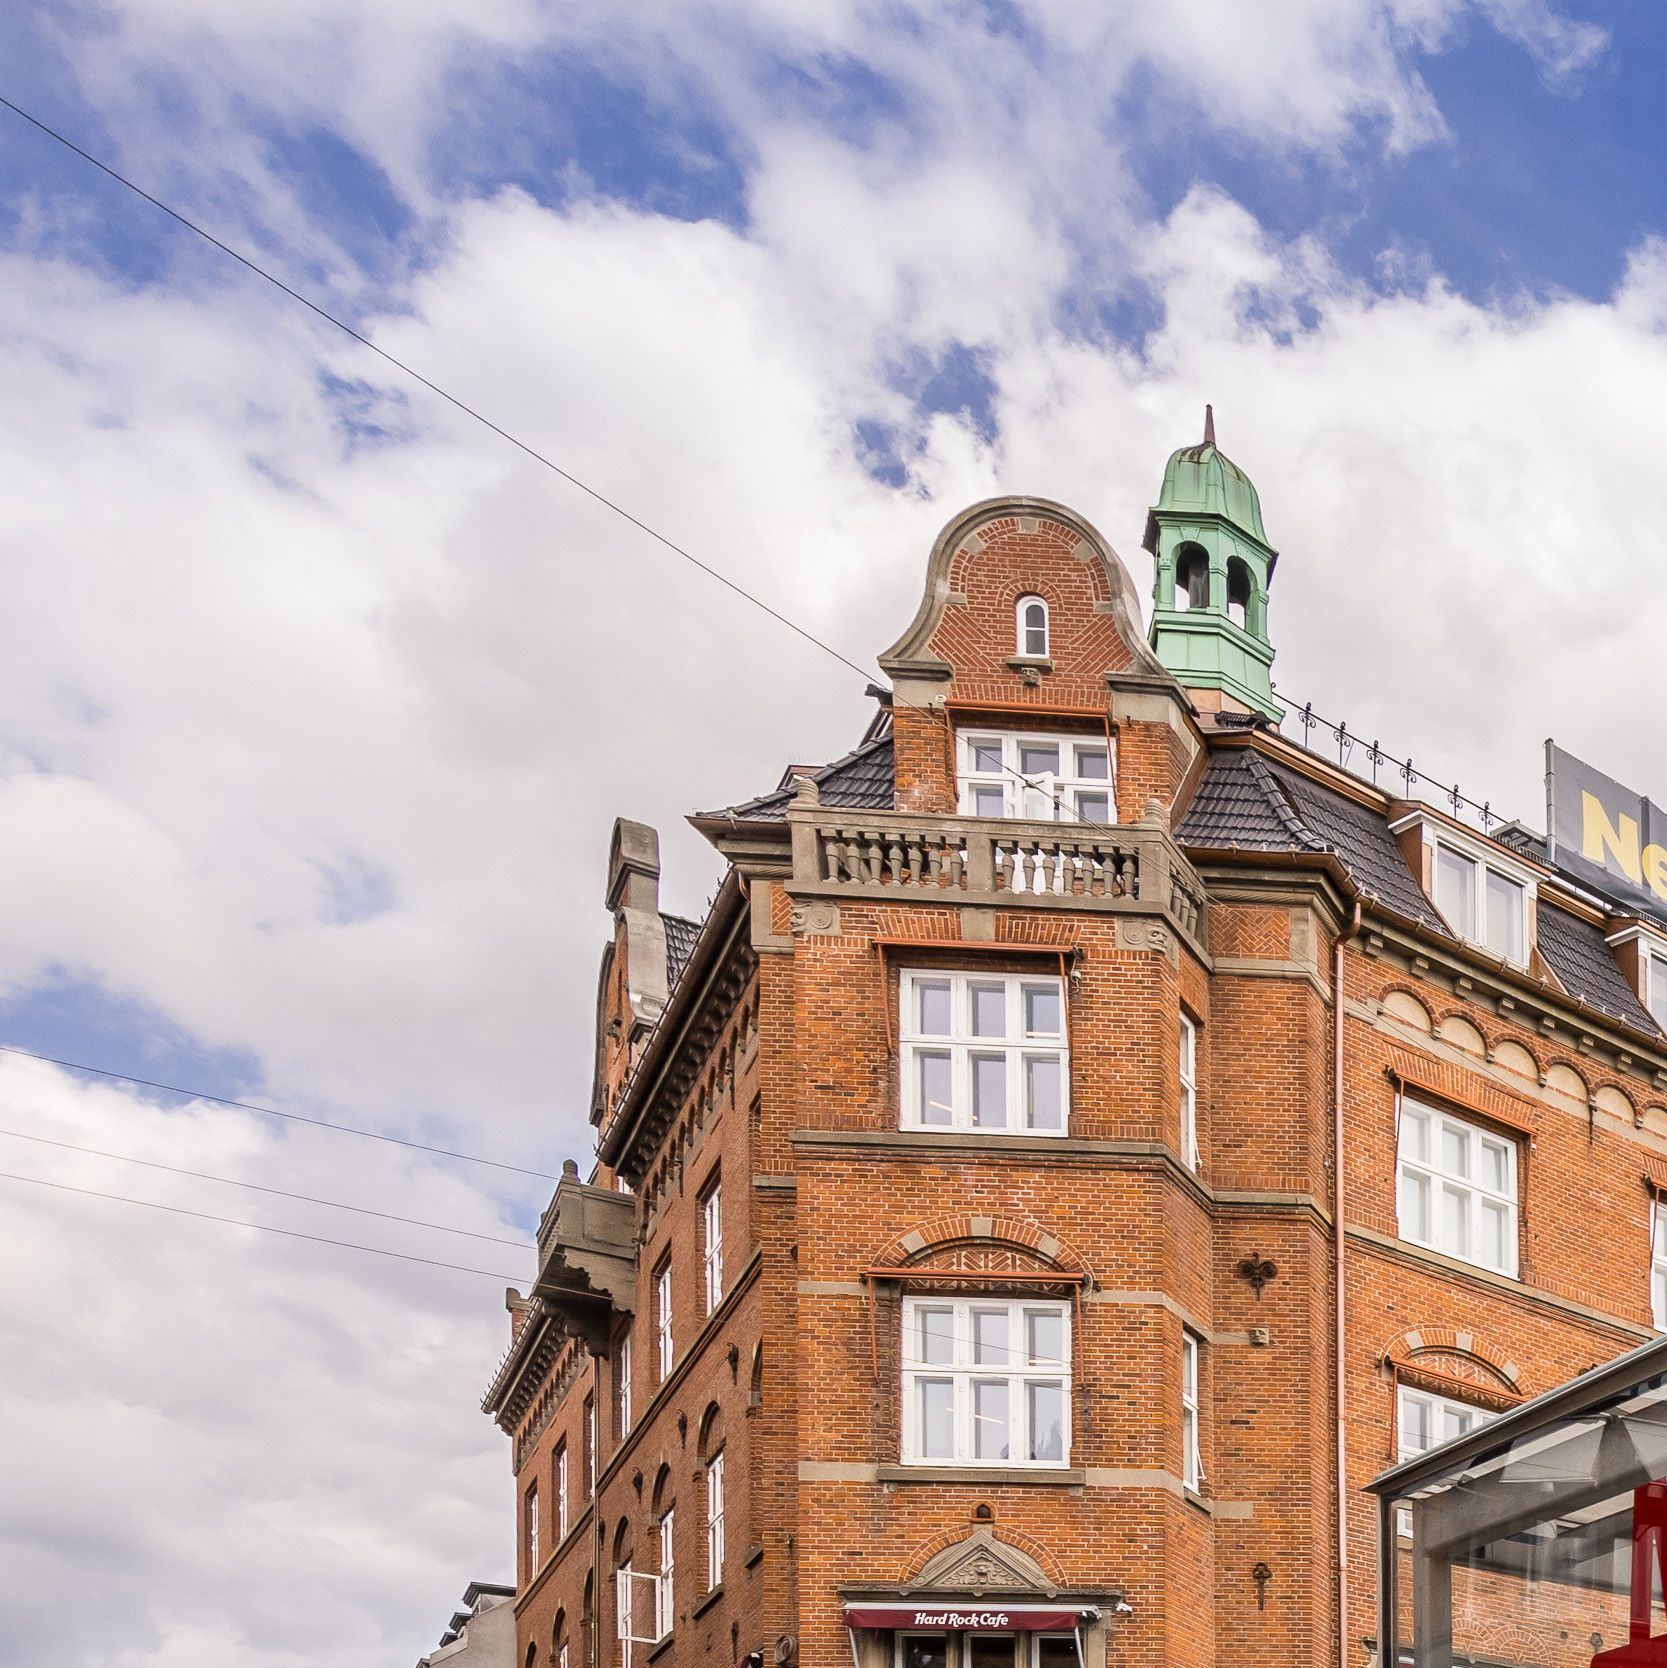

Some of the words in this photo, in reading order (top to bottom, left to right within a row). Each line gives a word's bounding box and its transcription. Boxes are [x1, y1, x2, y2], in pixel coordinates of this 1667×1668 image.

[914, 1612, 948, 1625] Hard
[948, 1613, 979, 1628] Rock
[979, 1613, 1009, 1628] Cafe
